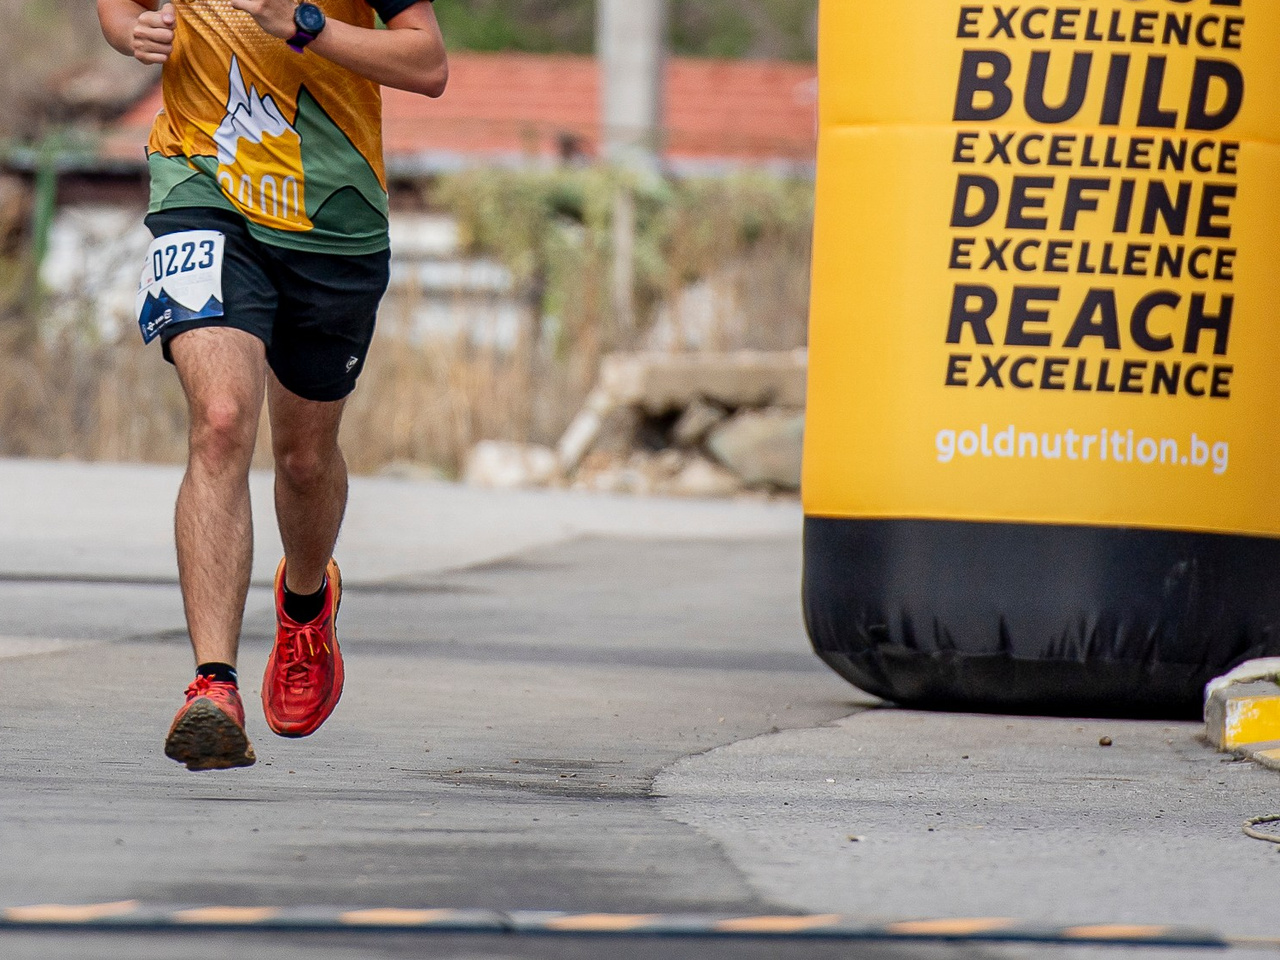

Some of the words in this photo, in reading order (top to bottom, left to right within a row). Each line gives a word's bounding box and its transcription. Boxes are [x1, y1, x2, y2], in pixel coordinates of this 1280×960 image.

[956, 6, 1246, 50] EXCELLENCE
[952, 49, 1245, 132] BUILD
[952, 132, 1241, 175] EXCELLENCE
[949, 173, 1238, 240] DEFINE
[153, 239, 216, 282] 0223
[948, 237, 1238, 282] EXCELLENCE
[945, 283, 1235, 357] REACH
[944, 354, 1234, 400] EXCELLENCE
[935, 423, 1230, 474] goldnutrition.bg
